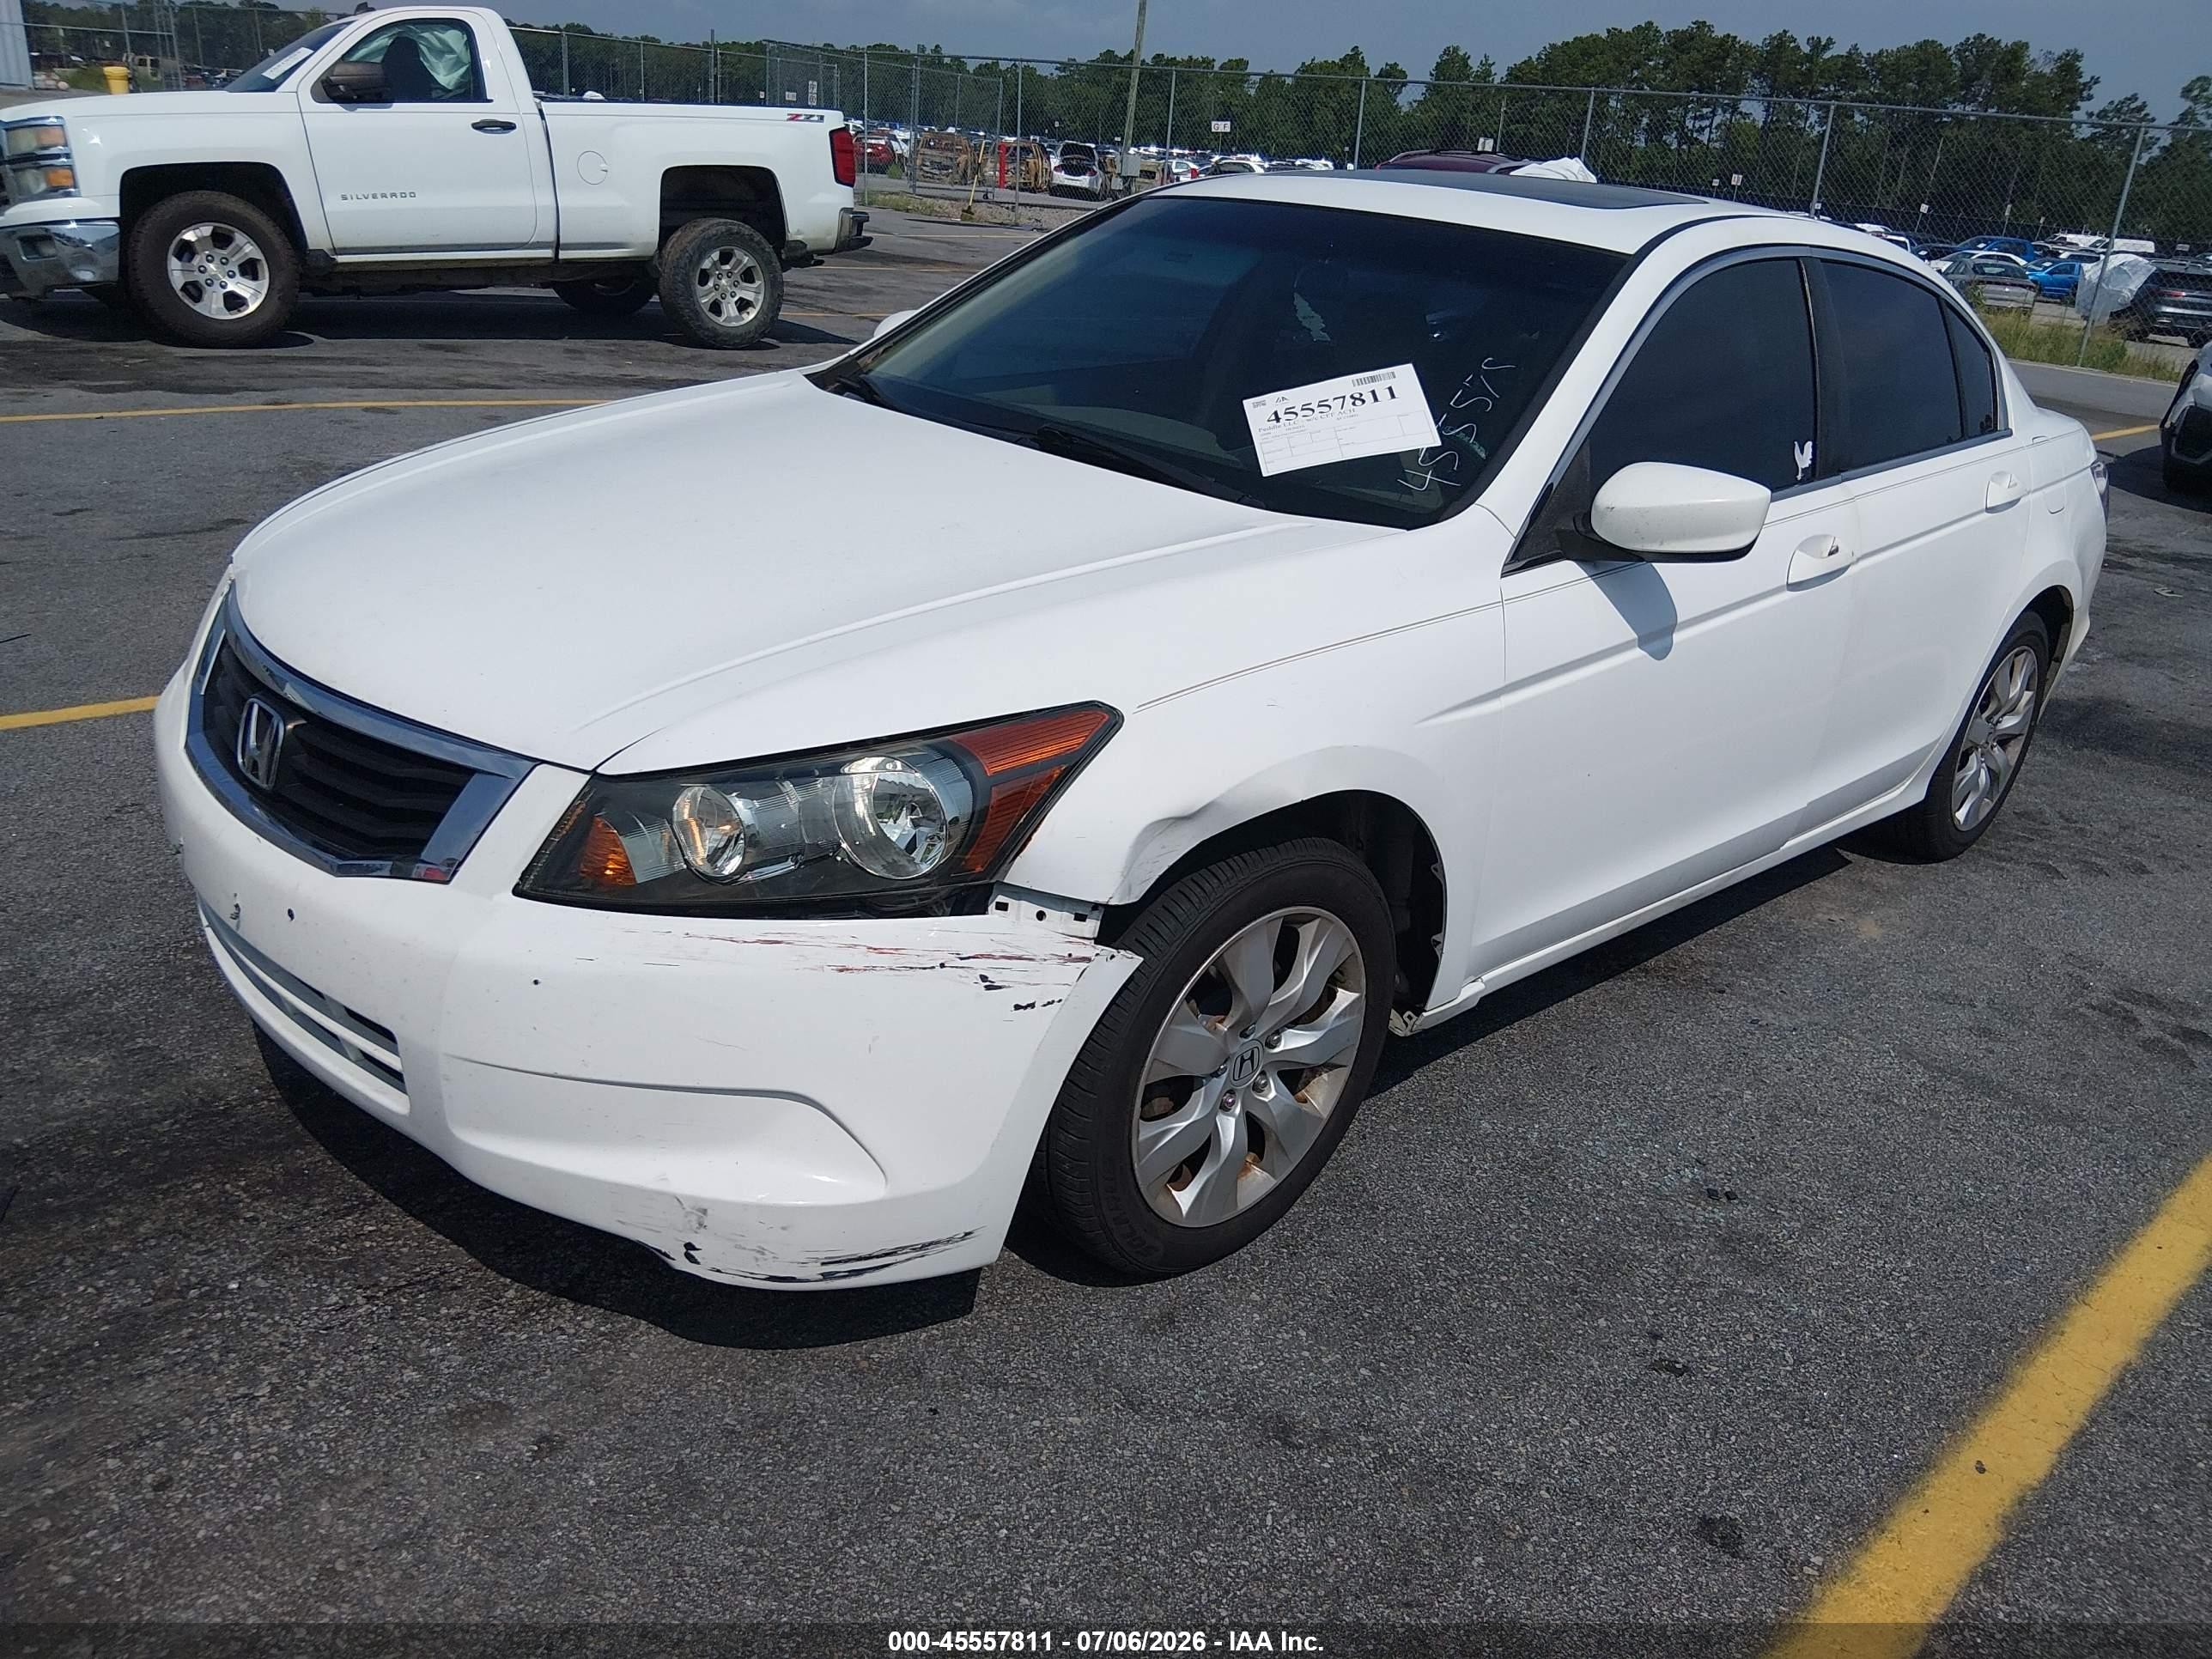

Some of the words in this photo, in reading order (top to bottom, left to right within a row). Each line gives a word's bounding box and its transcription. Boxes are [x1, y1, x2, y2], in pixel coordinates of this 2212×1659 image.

[786, 112, 825, 124] Z71
[340, 191, 416, 201] SILVERADO
[1266, 385, 1400, 424] 45557811
